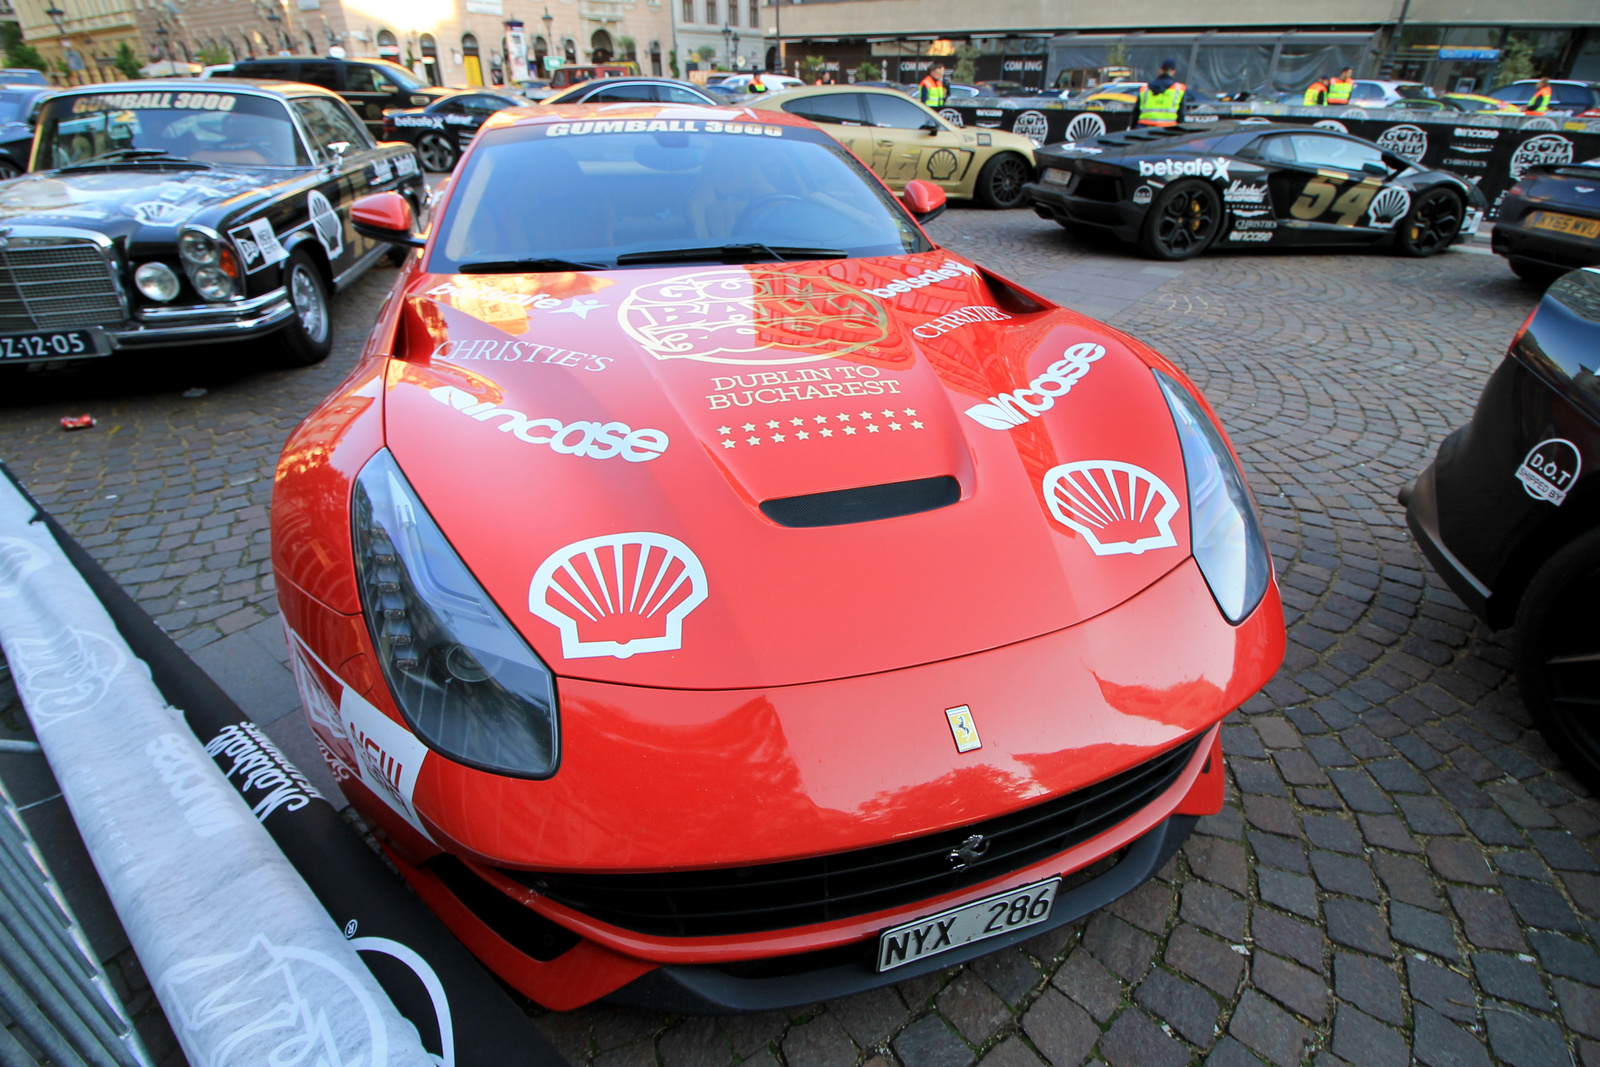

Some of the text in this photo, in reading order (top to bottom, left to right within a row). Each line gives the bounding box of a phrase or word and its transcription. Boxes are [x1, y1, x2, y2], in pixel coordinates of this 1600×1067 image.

[72, 93, 237, 114] GUMBALL 3000
[545, 120, 783, 137] GUMBALL 3000
[1522, 140, 1570, 153] GUM
[1139, 158, 1214, 177] betsafe
[1290, 168, 1384, 229] 54
[424, 282, 563, 310] betsafe
[863, 262, 961, 299] betsafe
[912, 305, 1012, 340] CHRISTIE'S
[430, 339, 614, 372] CHRISTIE'S
[711, 365, 881, 391] DUBLIN TO
[705, 379, 902, 411] BUCHAREST
[1518, 466, 1564, 502] SHIPPED BY
[1530, 453, 1572, 486] D.O.T
[204, 724, 310, 823] Marshall
[884, 887, 1050, 966] NYX 286
